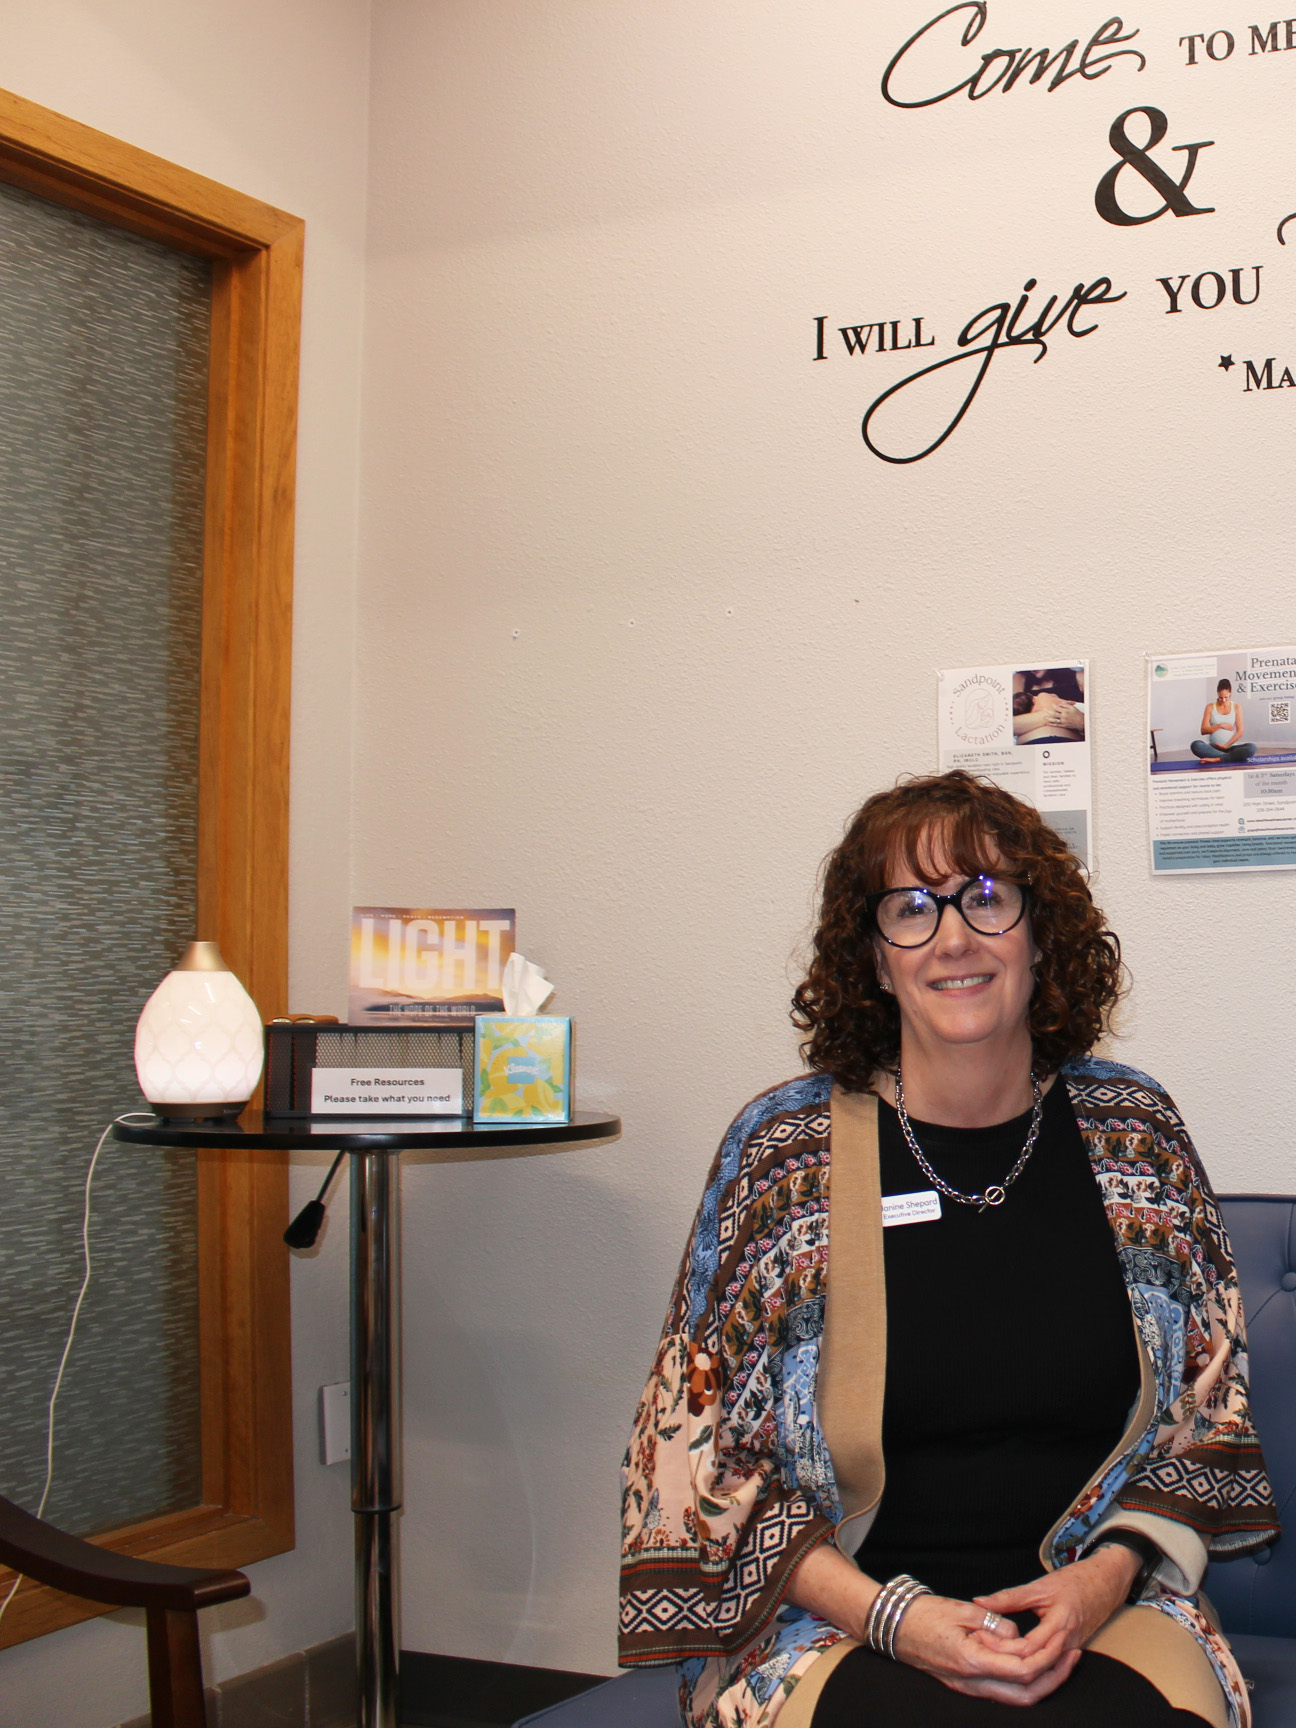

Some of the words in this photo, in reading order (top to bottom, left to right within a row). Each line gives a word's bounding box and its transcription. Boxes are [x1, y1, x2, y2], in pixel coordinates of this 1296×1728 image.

[881, 1, 1146, 109] Come
[1179, 30, 1235, 66] TO
[1094, 106, 1216, 227] &
[1155, 265, 1263, 314] YOU
[812, 315, 829, 361] I
[837, 317, 936, 356] WILL
[861, 276, 1127, 464] give
[953, 674, 1005, 697] Sandpoint
[1236, 682, 1246, 693] &
[955, 723, 1005, 745] Lactation
[359, 918, 510, 990] LIGHT
[389, 1004, 402, 1017] THE
[404, 1005, 423, 1017] HOPE
[425, 1005, 434, 1017] OF
[436, 1005, 449, 1017] THE
[451, 1005, 476, 1017] WORLD
[350, 1078, 372, 1087] Free
[374, 1078, 425, 1087] Resources
[323, 1094, 356, 1103] Please
[358, 1094, 379, 1103] take
[381, 1094, 405, 1103] what
[406, 1095, 424, 1104] you
[427, 1093, 451, 1102] need
[883, 1211, 911, 1220] Executive
[912, 1208, 936, 1216] Director
[905, 1197, 938, 1209] Shepard
